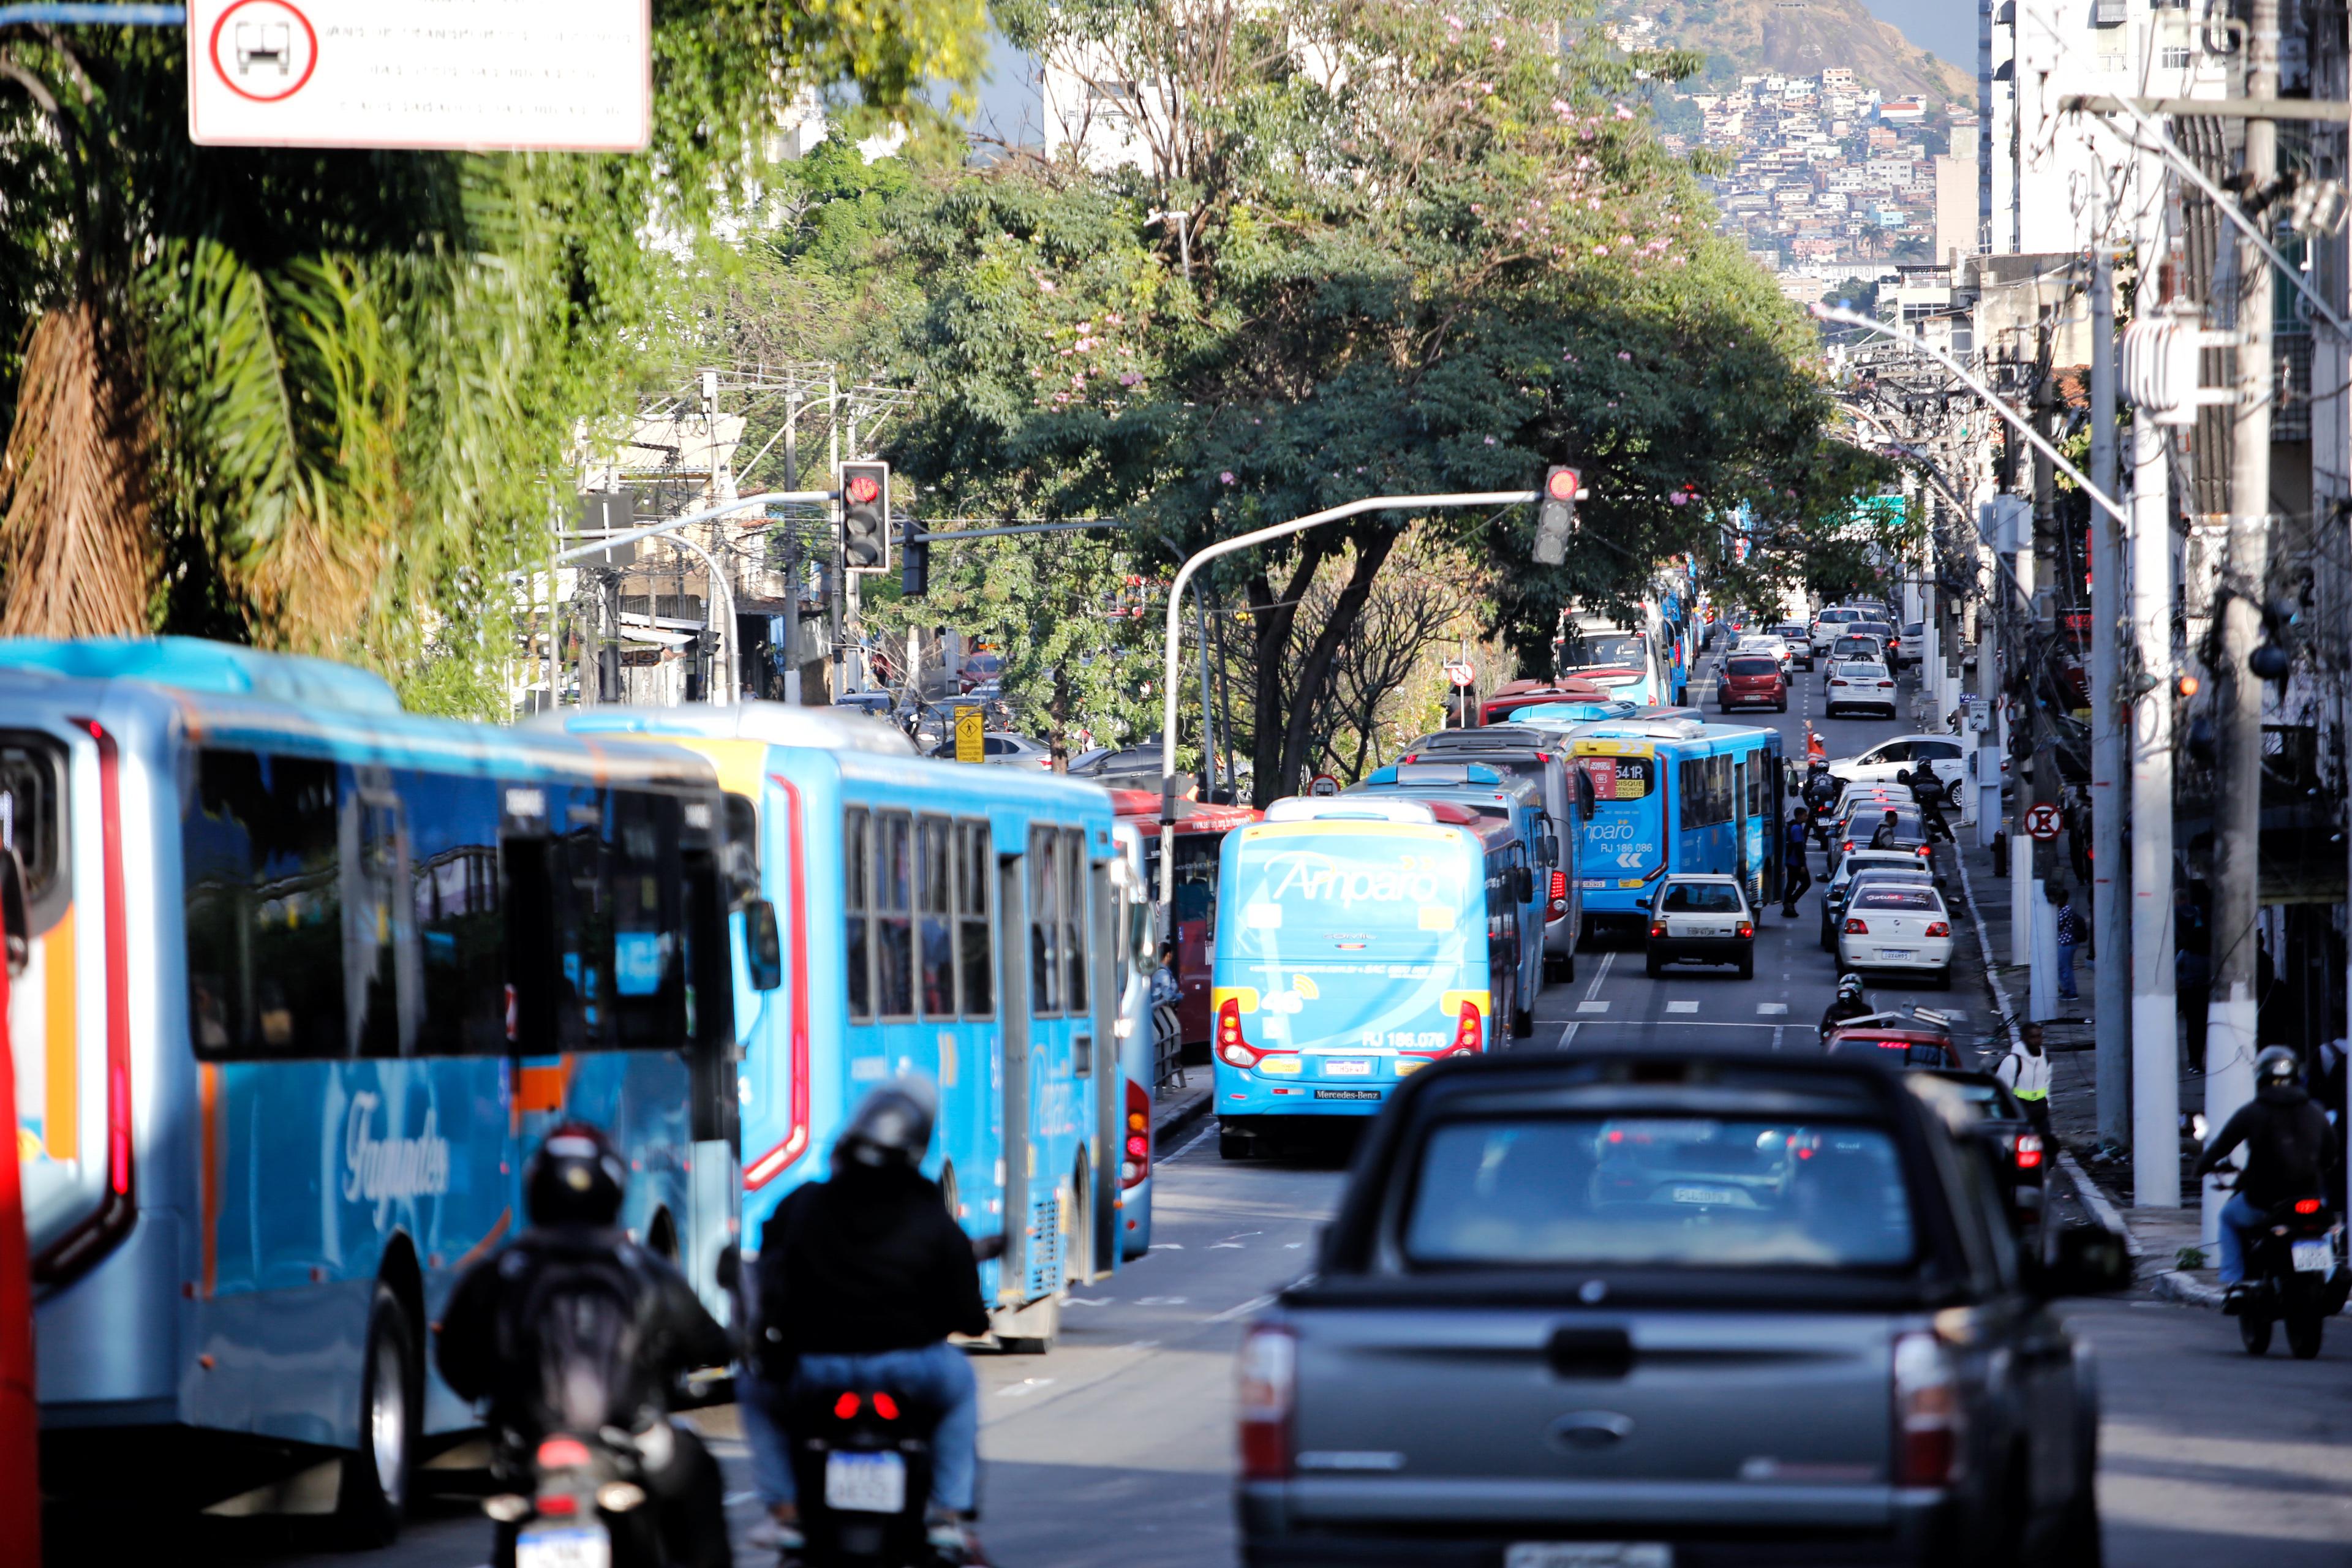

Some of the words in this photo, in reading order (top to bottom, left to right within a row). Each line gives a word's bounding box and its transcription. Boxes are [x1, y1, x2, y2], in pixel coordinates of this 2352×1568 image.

[1600, 844, 1613, 853] RJ
[1617, 844, 1633, 853] 186
[1635, 844, 1653, 853] 086
[1265, 853, 1437, 909] Amparo
[1362, 1031, 1385, 1047] RJ
[1316, 1090, 1378, 1100] Mercedes-Benz
